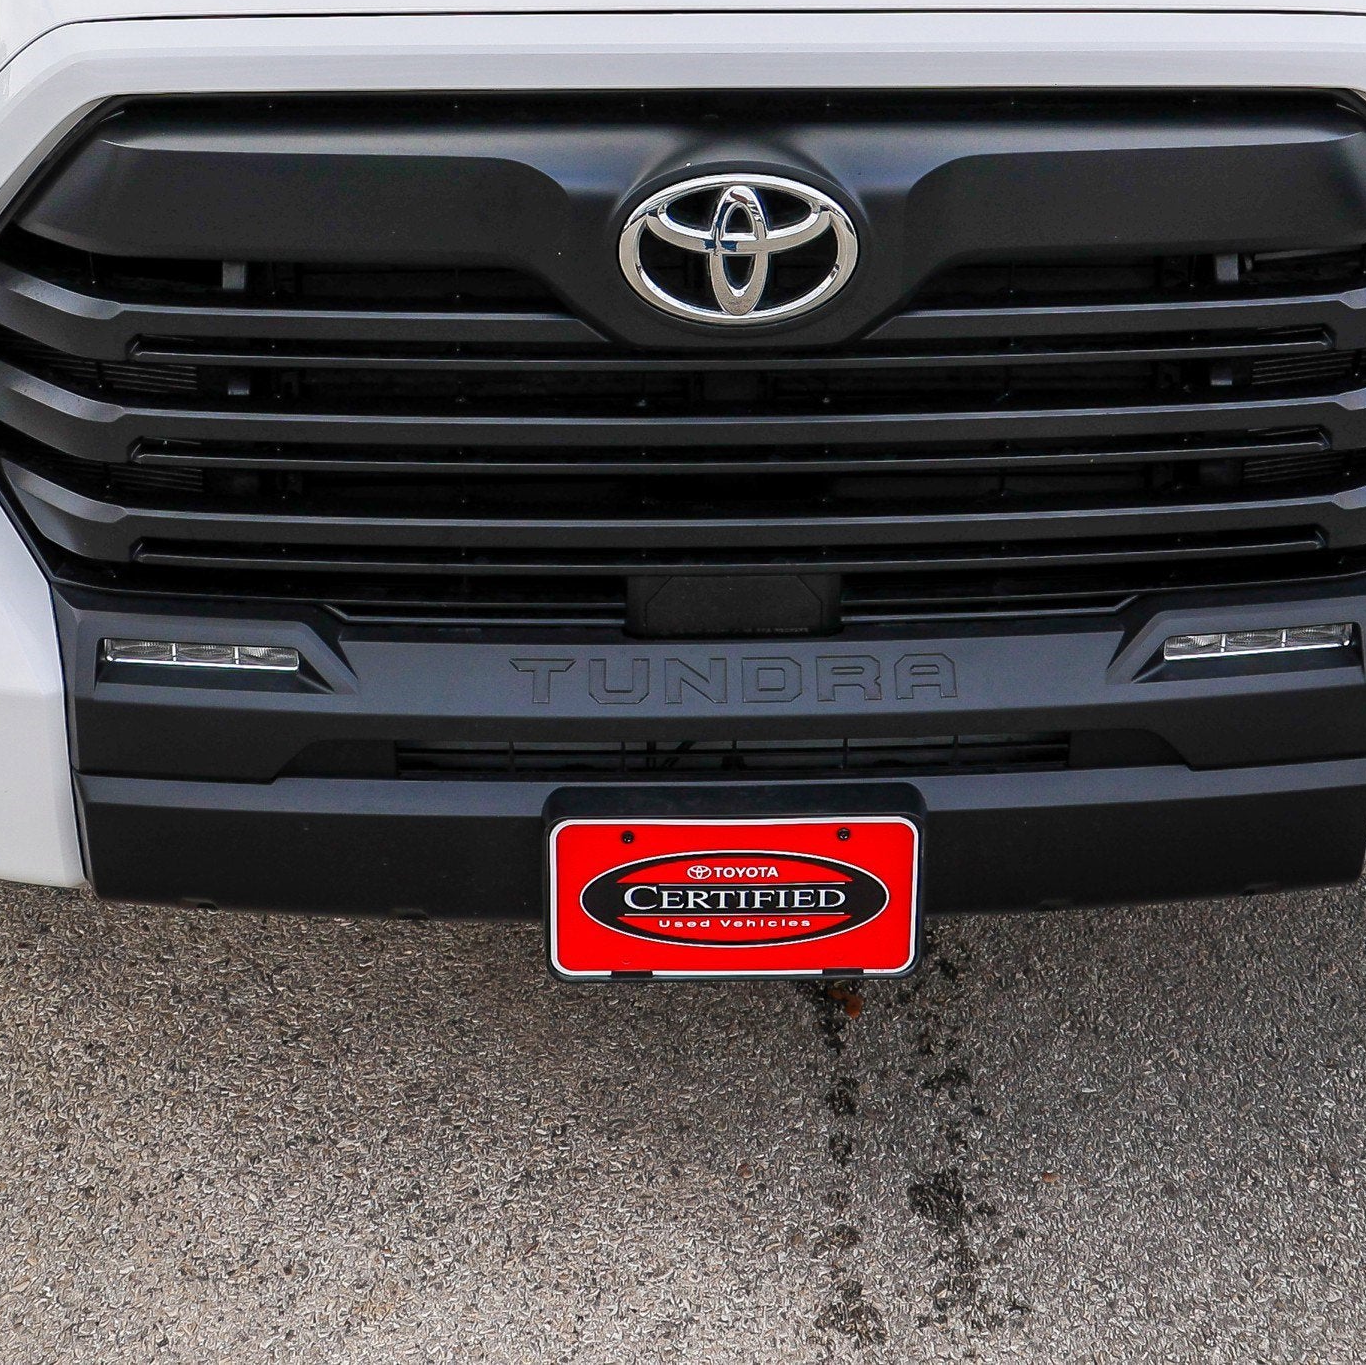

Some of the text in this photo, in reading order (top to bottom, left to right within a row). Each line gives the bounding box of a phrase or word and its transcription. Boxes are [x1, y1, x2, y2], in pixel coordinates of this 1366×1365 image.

[508, 652, 958, 705] TUNDRA
[713, 866, 779, 878] TOYOTA
[623, 885, 846, 910] CERTIFIED
[658, 919, 812, 928] Used Vehicles
